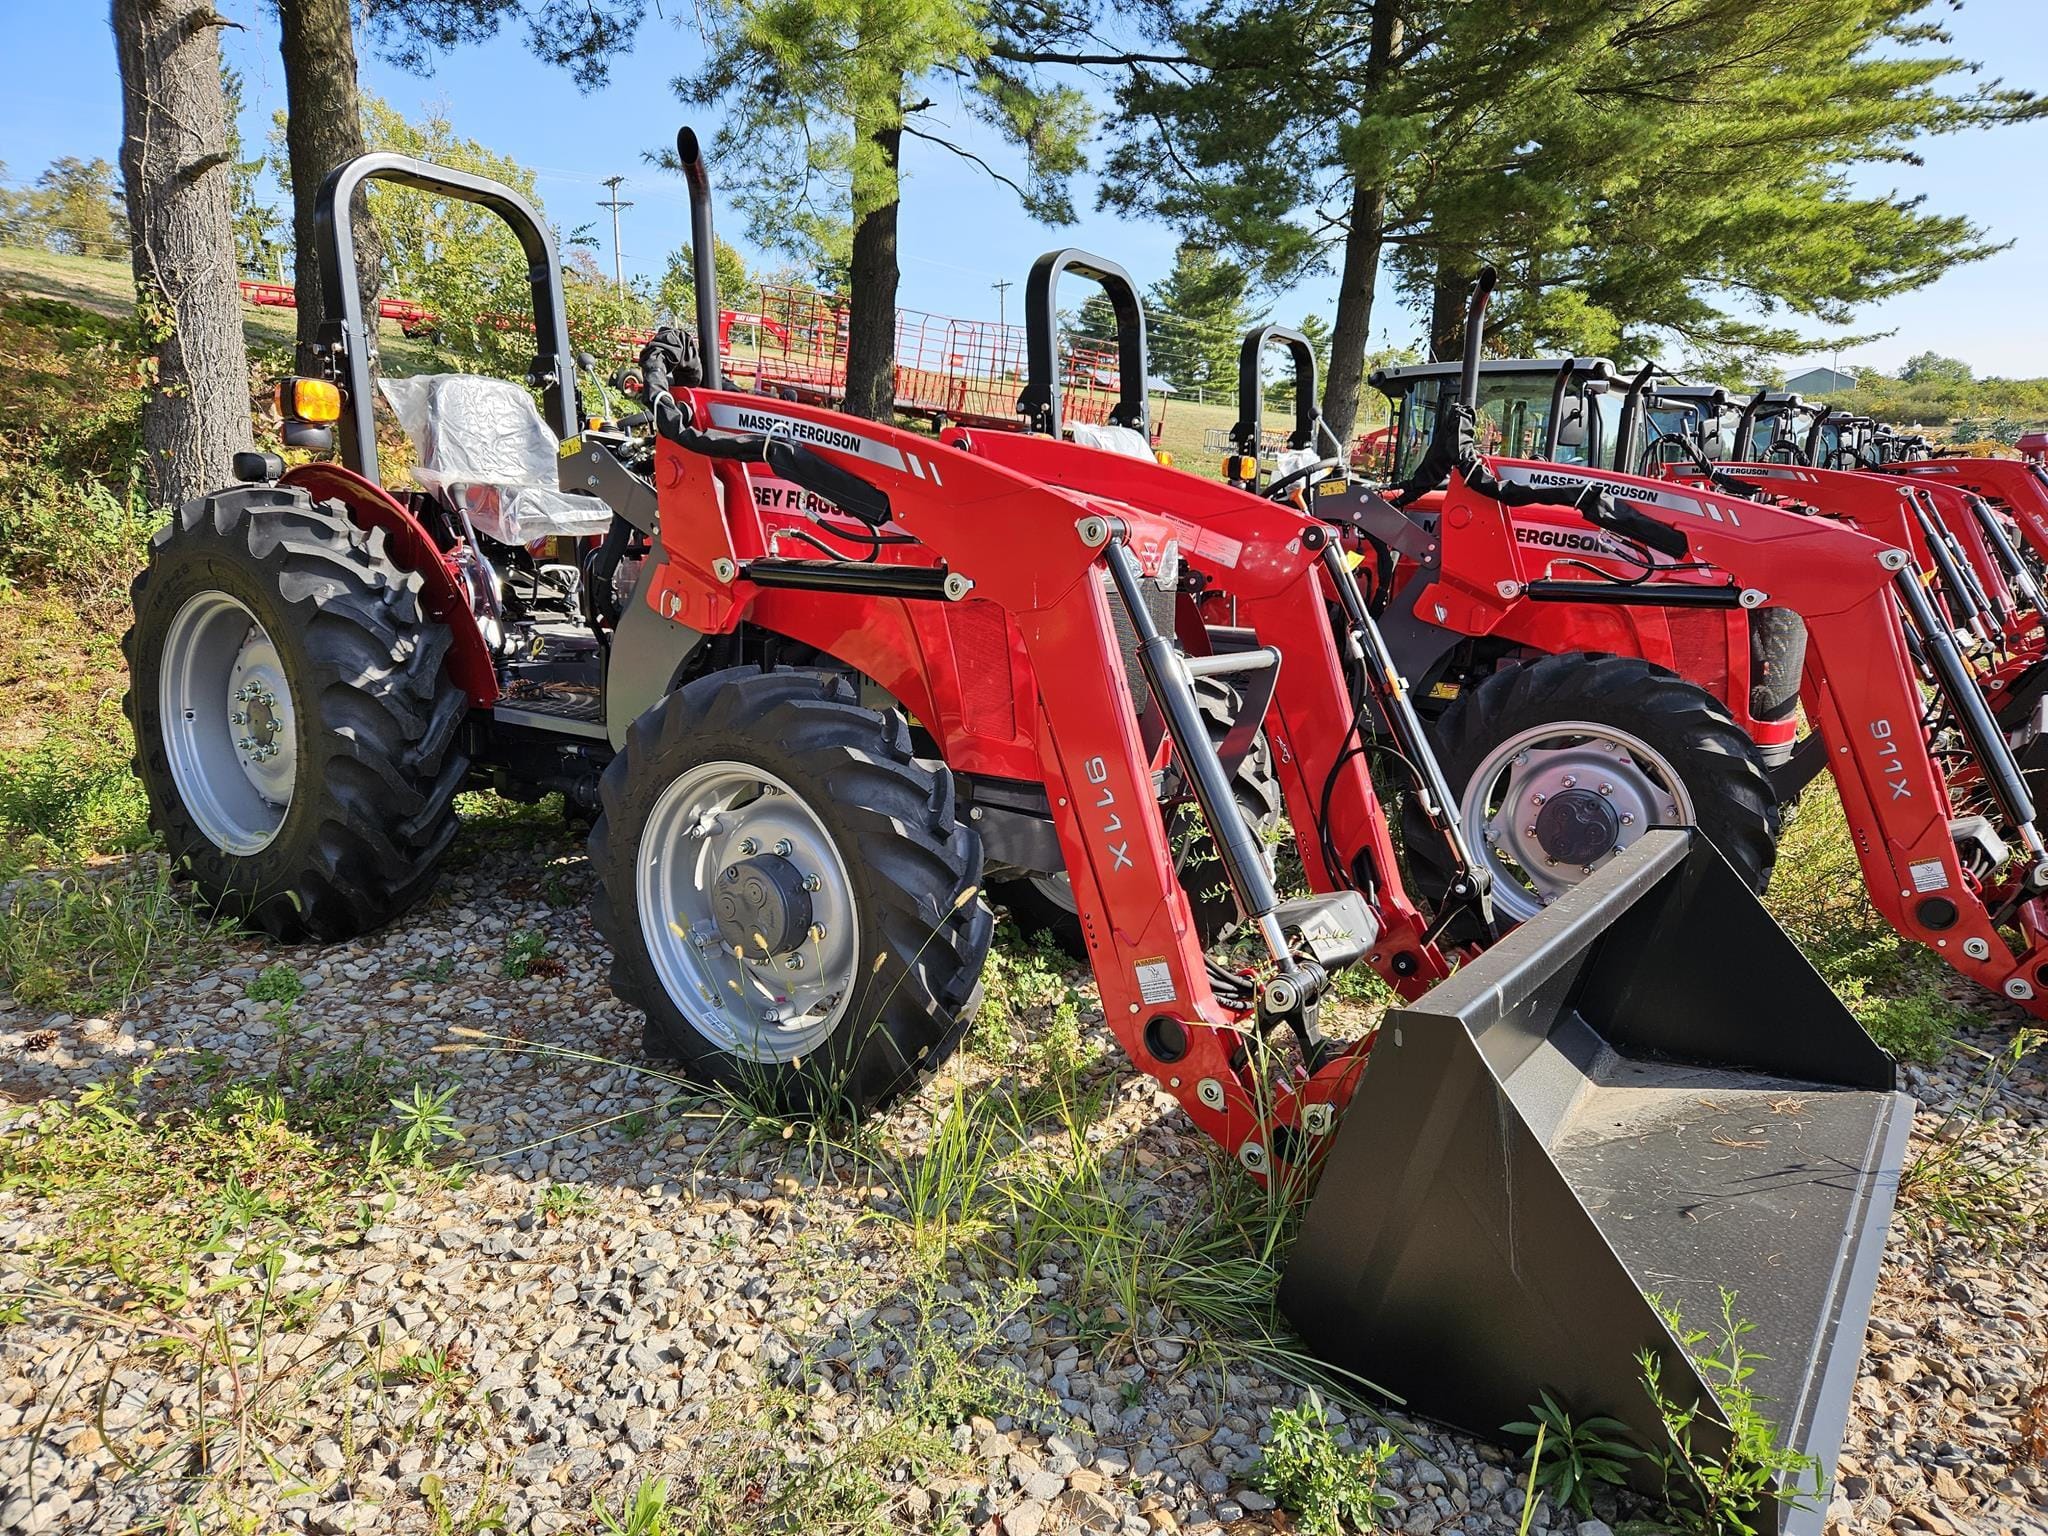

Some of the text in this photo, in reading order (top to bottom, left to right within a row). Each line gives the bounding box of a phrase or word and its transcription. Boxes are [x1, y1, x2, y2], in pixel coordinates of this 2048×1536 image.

[792, 422, 861, 453] FERGUSON
[1726, 467, 1769, 476] FERGUSON
[1869, 719, 1912, 801] 911X
[1084, 755, 1134, 873] 911X
